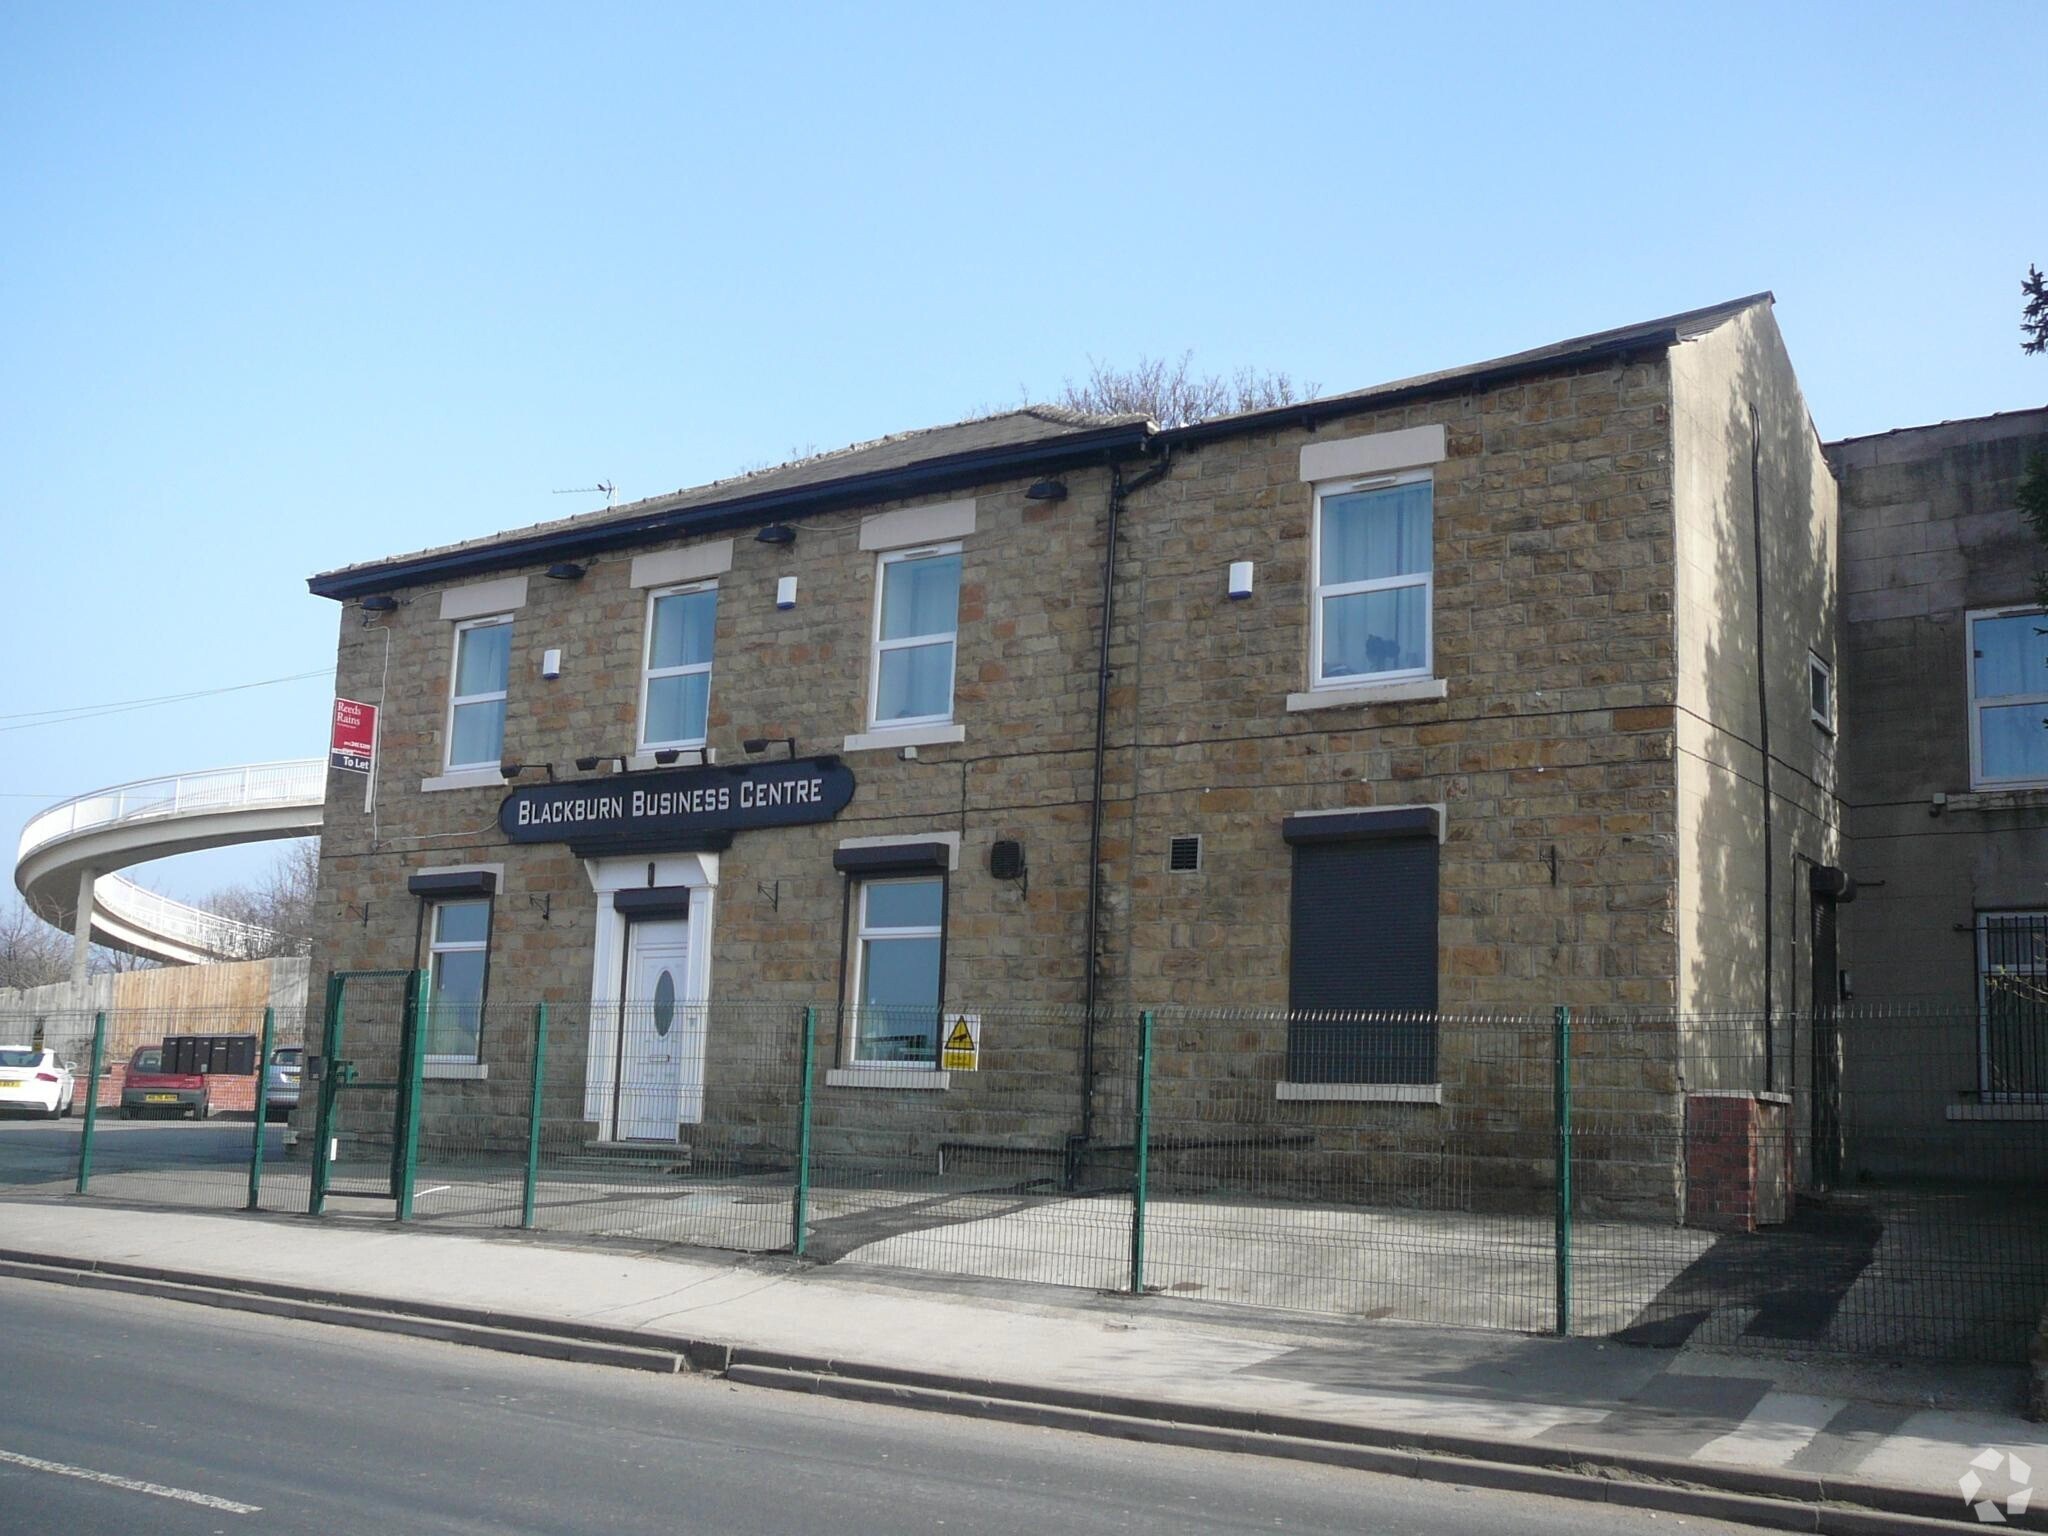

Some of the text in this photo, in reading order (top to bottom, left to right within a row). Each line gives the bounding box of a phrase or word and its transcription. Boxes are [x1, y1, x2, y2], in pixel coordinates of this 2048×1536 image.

[337, 701, 361, 716] Reeds
[336, 711, 360, 726] Rains
[343, 756, 369, 770] To Let
[518, 778, 823, 825] BLACKBURN BUSINESS CENTRE
